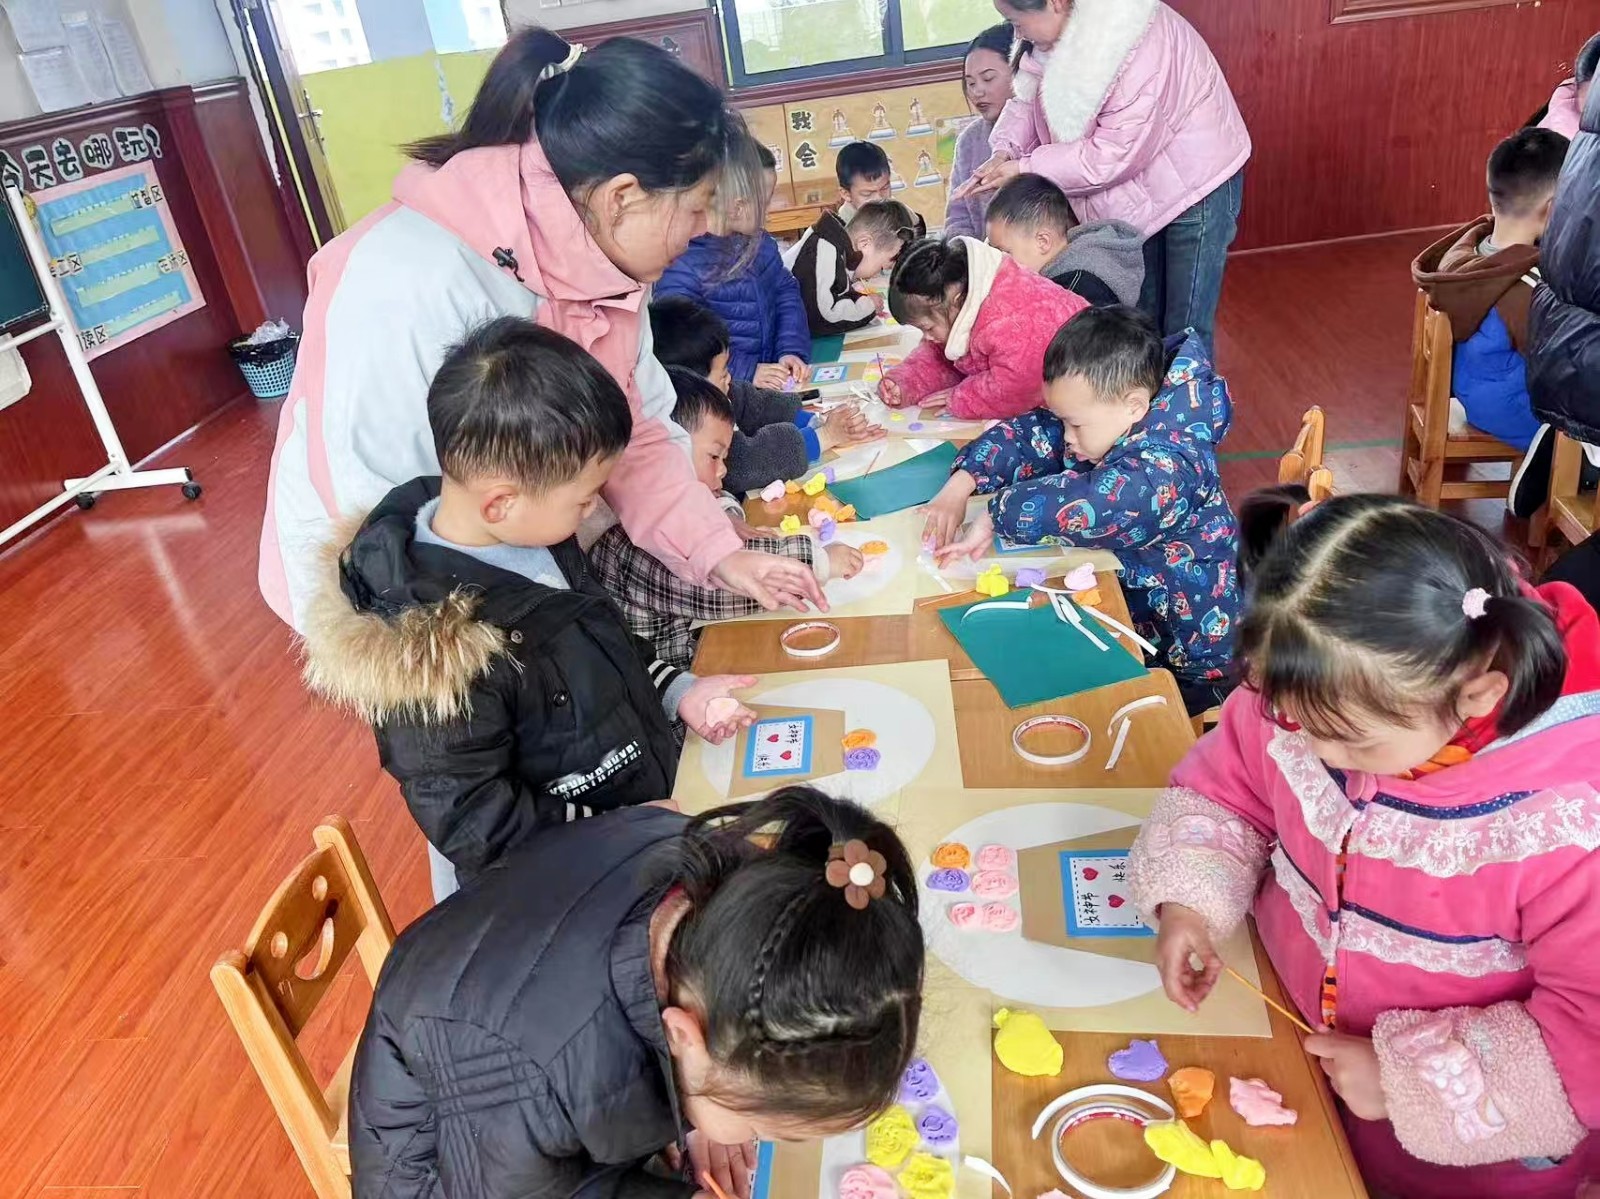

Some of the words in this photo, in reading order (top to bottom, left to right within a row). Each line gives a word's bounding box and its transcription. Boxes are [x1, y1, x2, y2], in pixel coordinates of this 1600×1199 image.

[791, 111, 817, 168] 我会
[50, 254, 82, 277] 工区
[77, 325, 108, 351] 读区
[1098, 467, 1120, 495] PAW
[1108, 862, 1126, 882] 快乐
[1081, 892, 1100, 923] 女神节
